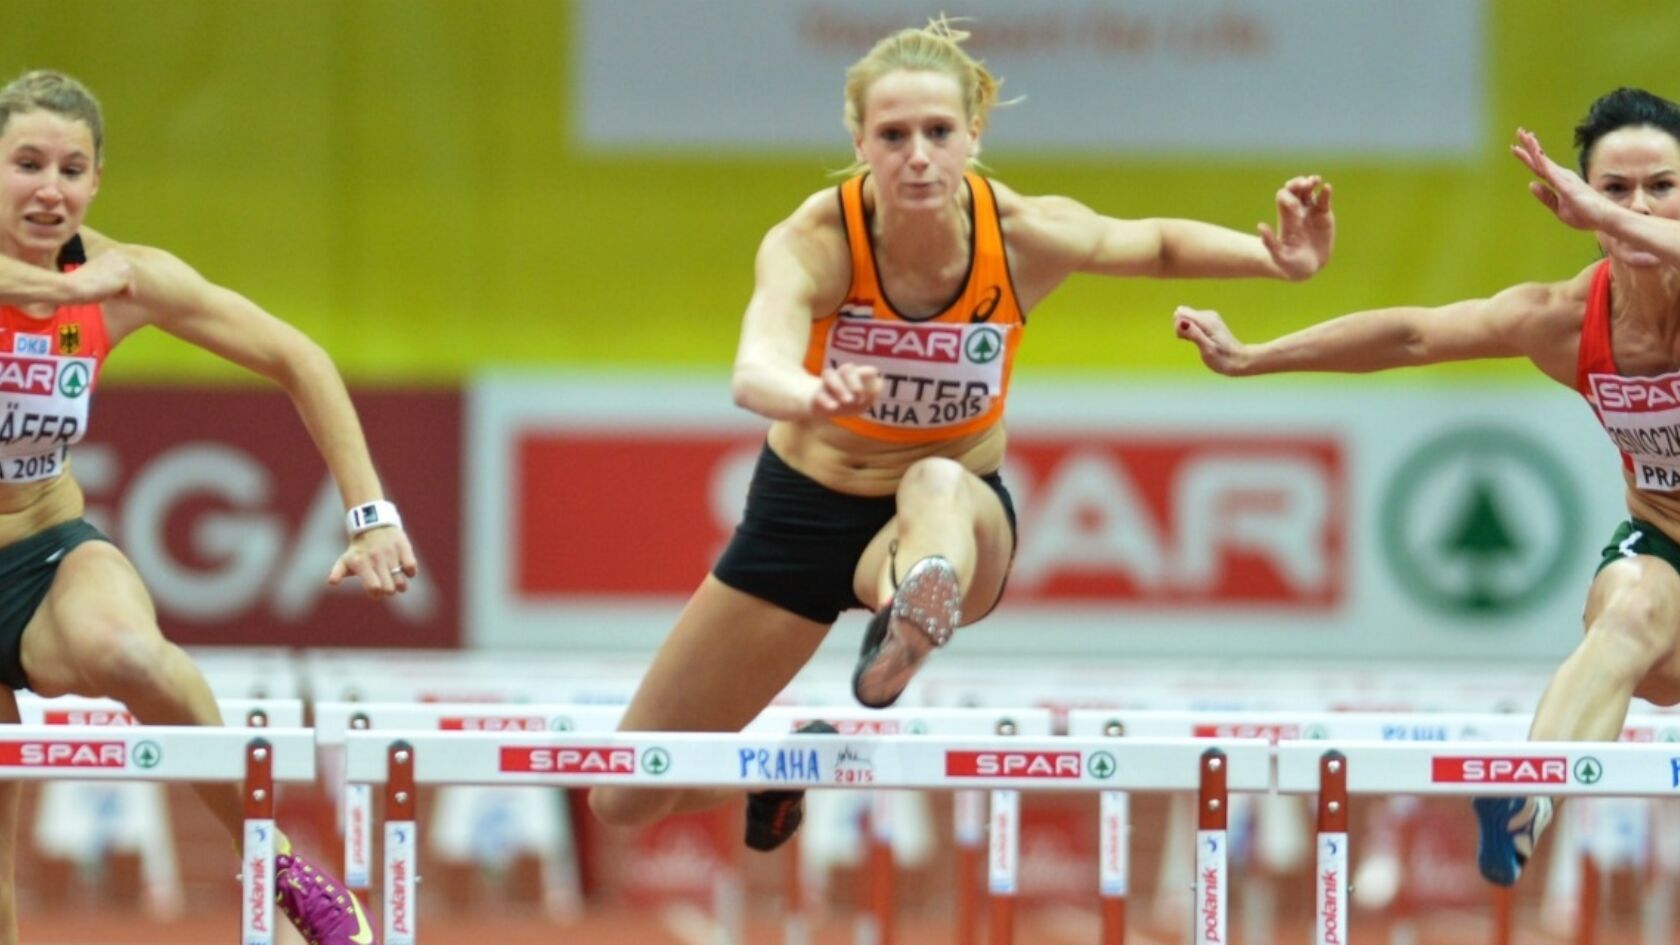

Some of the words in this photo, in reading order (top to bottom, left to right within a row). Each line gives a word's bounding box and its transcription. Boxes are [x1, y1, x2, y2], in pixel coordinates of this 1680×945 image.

[17, 336, 48, 353] DKB
[835, 326, 959, 358] SPAR
[0, 361, 54, 391] AR
[928, 396, 982, 424] 2015
[13, 453, 56, 480] 2015
[76, 441, 438, 622] GA
[20, 743, 124, 765] SPAR
[529, 749, 633, 771] SPAR
[738, 748, 820, 781] PRAHA
[976, 753, 1080, 775] SPAR
[835, 769, 873, 783] 2015
[1462, 759, 1565, 781] SPAR
[252, 858, 268, 932] polanik
[391, 859, 408, 934] polanik
[1202, 868, 1220, 942] polanik
[1321, 869, 1340, 945] polanik
